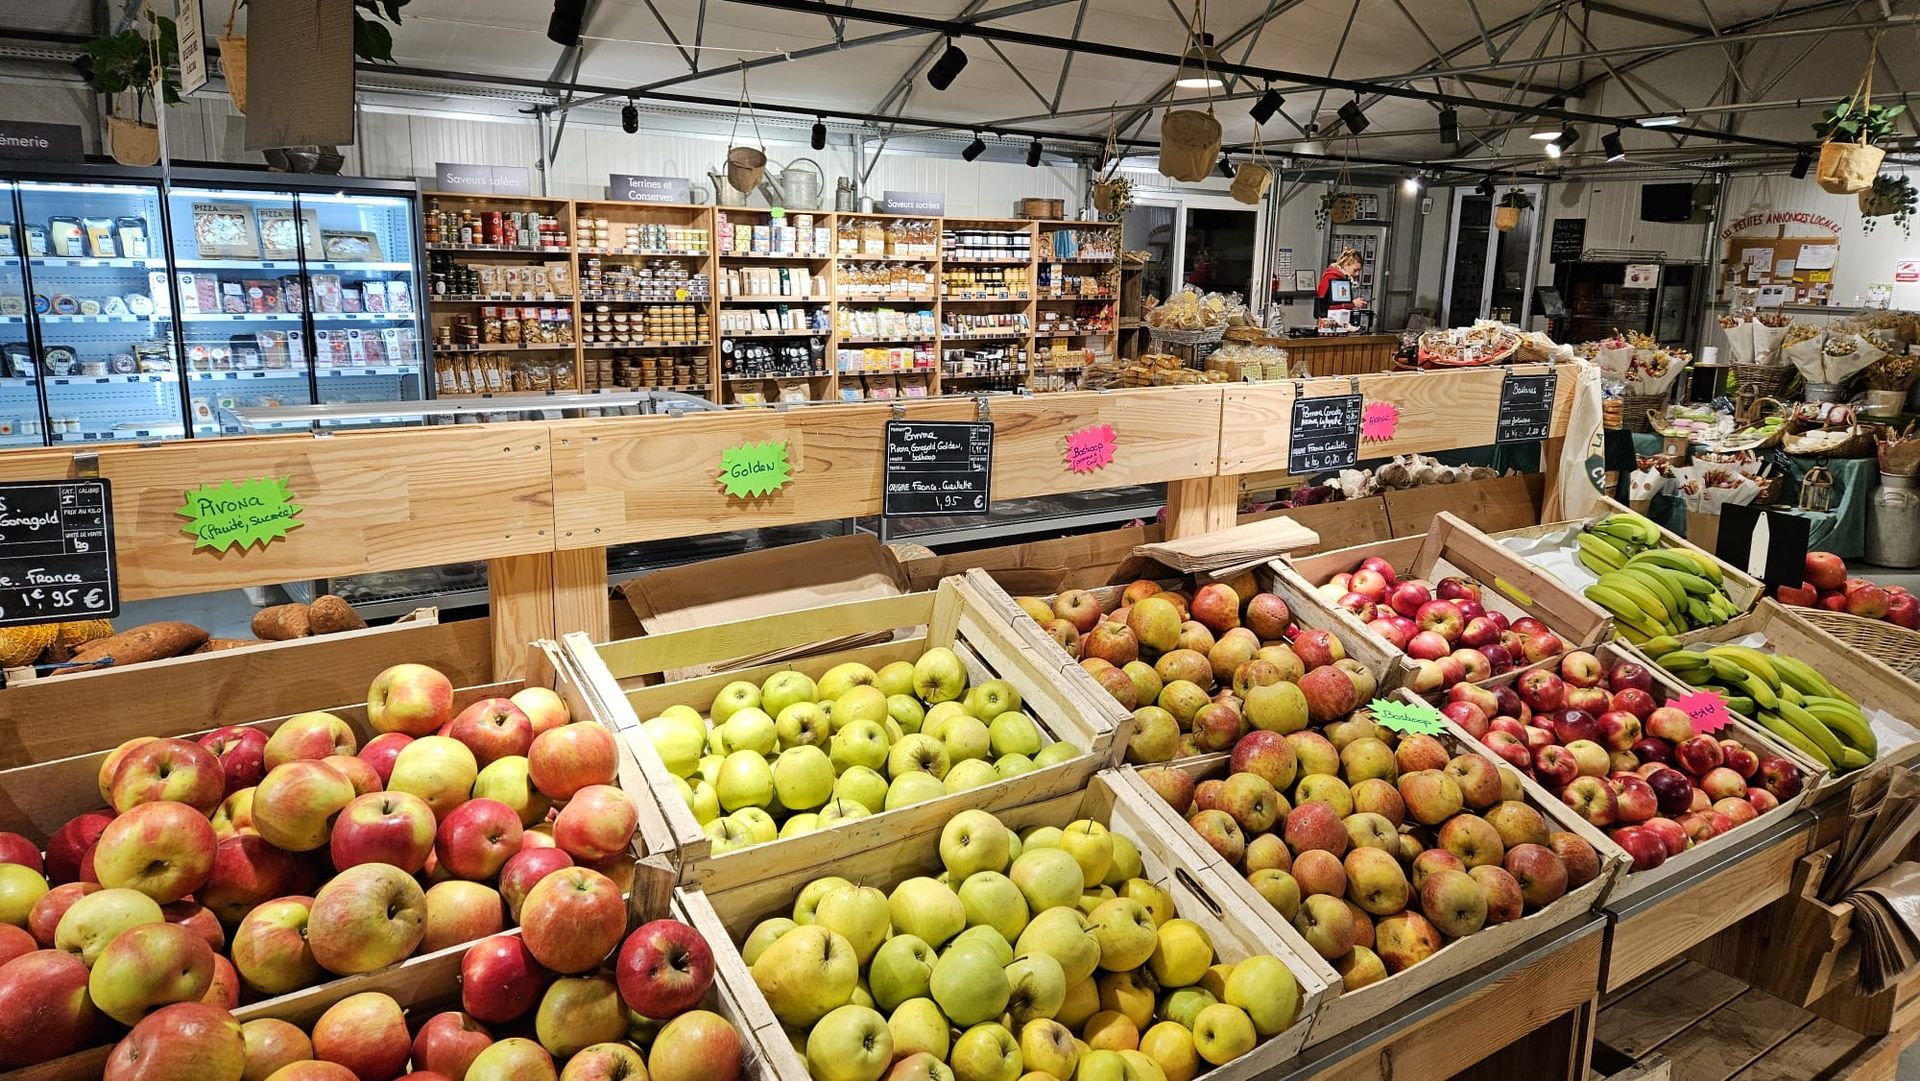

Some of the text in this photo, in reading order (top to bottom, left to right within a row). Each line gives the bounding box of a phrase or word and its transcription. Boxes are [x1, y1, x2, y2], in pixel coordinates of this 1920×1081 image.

[446, 173, 520, 187] Saveurs salées
[628, 177, 672, 189] Terrines et
[628, 190, 673, 201] Conserves
[194, 204, 218, 212] PIZZA
[887, 199, 940, 209] Saveurs sucrées
[260, 210, 283, 218] PIZZA
[1733, 214, 1764, 232] PETITES
[1766, 212, 1810, 225] ANNONCES
[1810, 213, 1842, 233] LOCALES
[731, 460, 775, 478] Golden
[936, 495, 984, 510] 1,95 €
